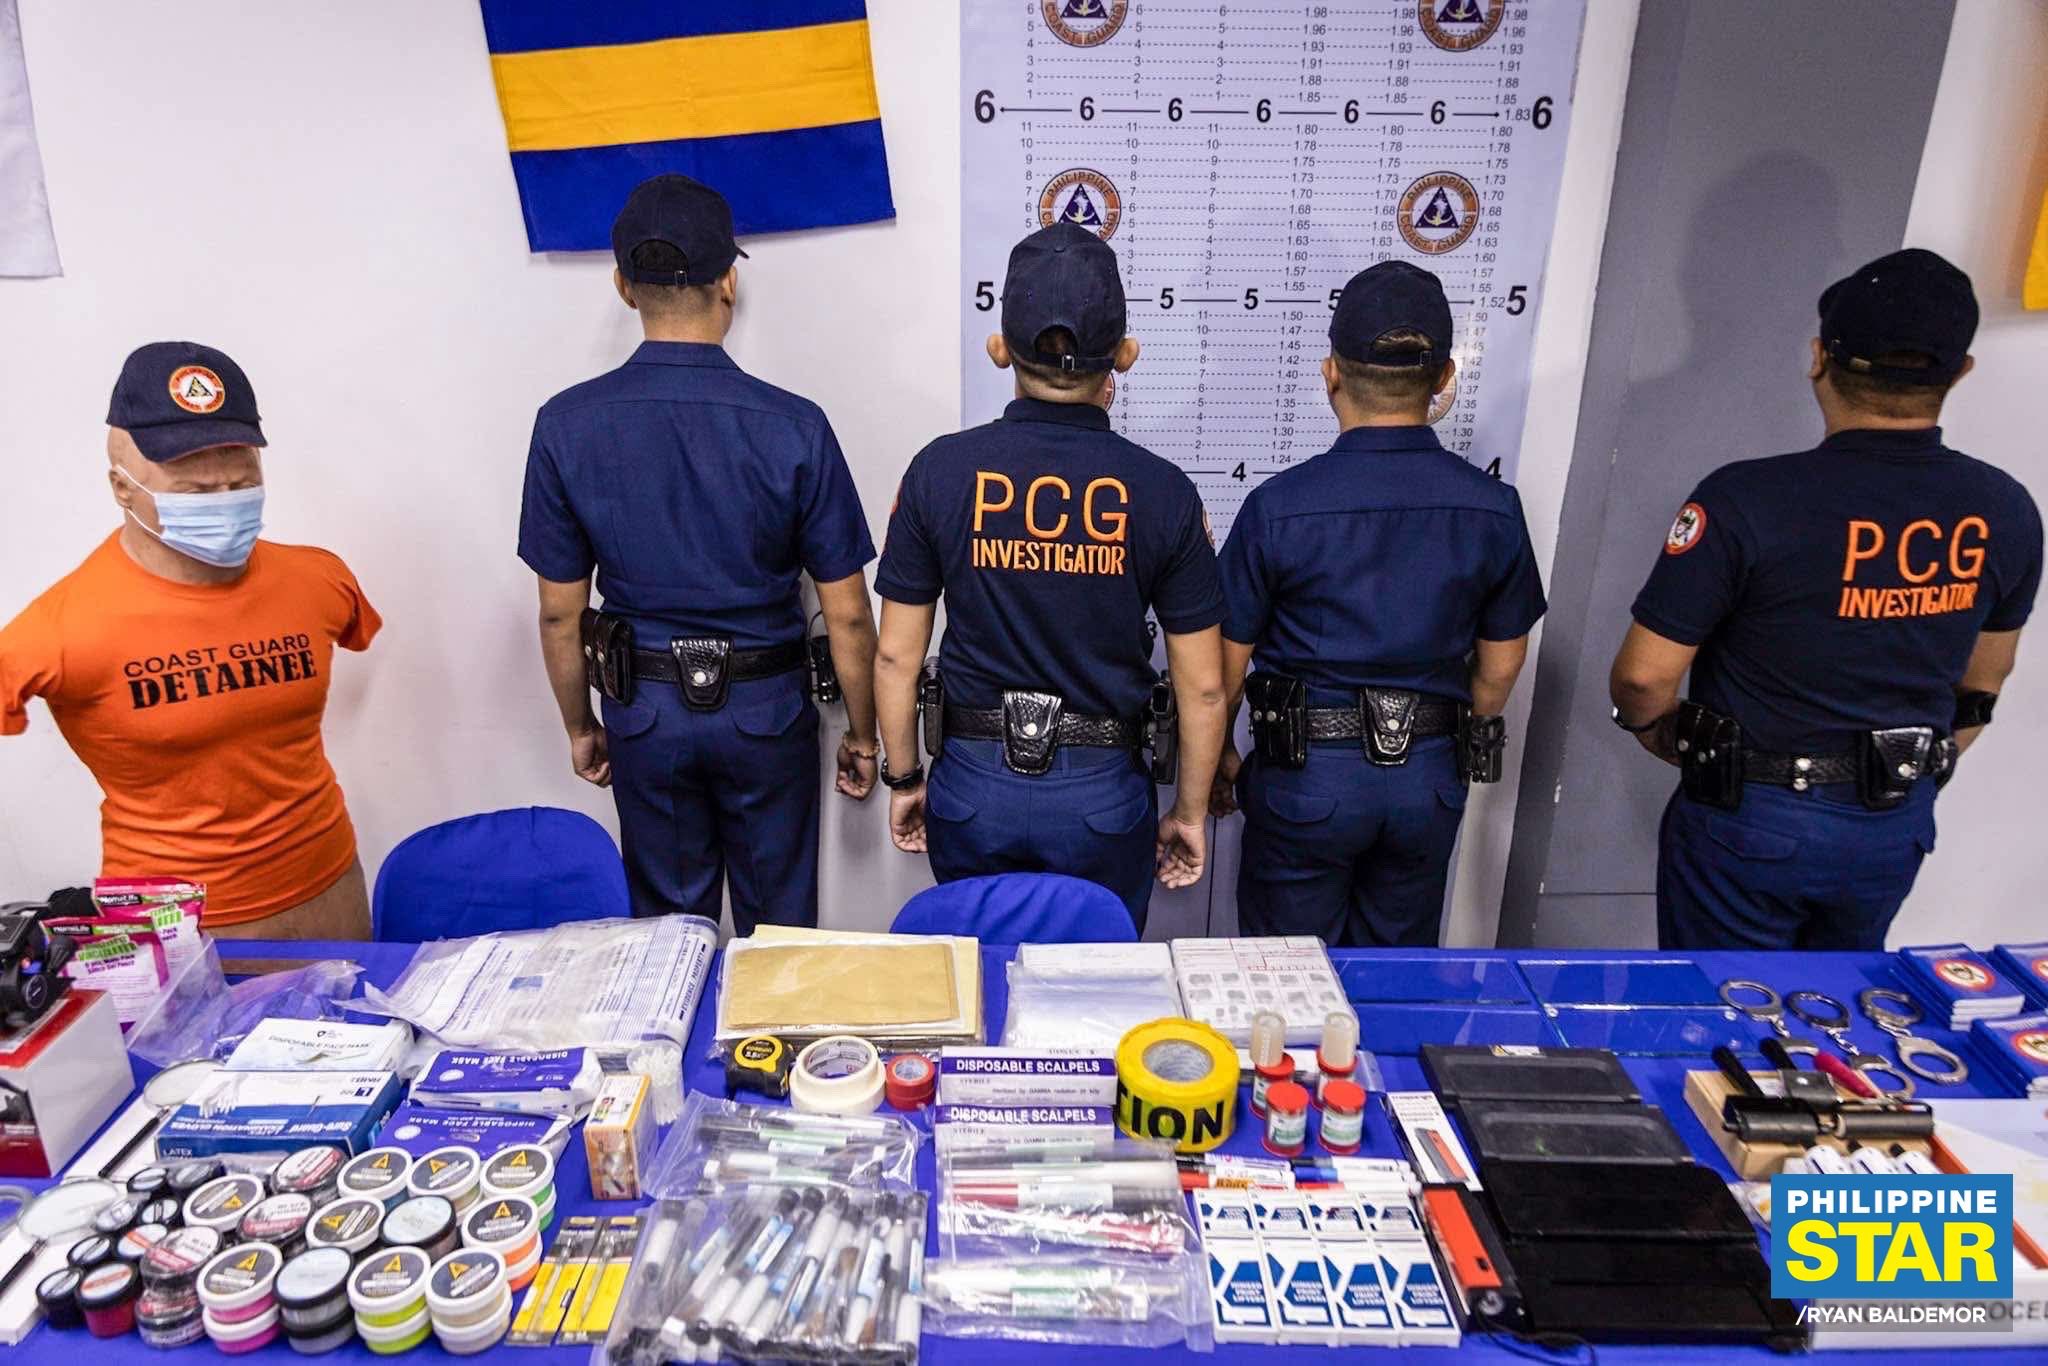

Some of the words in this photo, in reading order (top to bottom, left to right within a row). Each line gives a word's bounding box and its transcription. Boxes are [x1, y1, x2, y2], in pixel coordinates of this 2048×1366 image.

[1027, 4, 1034, 15] 6
[1136, 5, 1143, 16] 6
[1220, 6, 1226, 17] 6
[1306, 7, 1328, 18] 1.98
[1028, 21, 1034, 32] 5
[1135, 22, 1142, 33] 5
[1219, 23, 1226, 34] 5
[1305, 25, 1326, 35] 1.96
[1027, 38, 1034, 49] 4
[1135, 39, 1142, 50] 4
[1218, 40, 1225, 51] 4
[1303, 41, 1325, 52] 1.93
[1027, 55, 1034, 66] 3
[1134, 56, 1141, 67] 3
[1217, 57, 1224, 68] 3
[1301, 58, 1323, 69] 1.91
[1027, 72, 1034, 83] 2
[1134, 73, 1141, 84] 2
[1216, 74, 1223, 84] 2
[1300, 75, 1322, 86] 1.88
[1028, 89, 1033, 100] 1
[1135, 90, 1140, 100] 1
[1216, 90, 1221, 101] 1
[1299, 92, 1321, 102] 1.85
[974, 89, 995, 124] 6
[1080, 96, 1095, 122] 6
[1168, 97, 1183, 122] 6
[1256, 98, 1272, 123] 6
[1344, 99, 1360, 124] 6
[1430, 100, 1446, 125] 6
[1506, 110, 1530, 120] 1.83
[1532, 95, 1553, 130] 6
[1023, 122, 1032, 133] 11
[1128, 122, 1138, 132] 11
[1209, 123, 1219, 134] 11
[1296, 124, 1318, 135] 1.80
[1022, 138, 1033, 149] 10
[1127, 138, 1138, 149] 10
[1208, 139, 1219, 150] 10
[1295, 140, 1317, 151] 1.78
[1026, 154, 1033, 165] 9
[1131, 154, 1138, 165] 9
[1211, 155, 1218, 166] 9
[1294, 157, 1316, 168] 1.75
[1026, 170, 1032, 181] 8
[1130, 170, 1137, 181] 8
[1210, 171, 1216, 182] 8
[1292, 173, 1314, 184] 1.73
[1047, 171, 1114, 198] PHILIPPINE
[1407, 175, 1474, 201] PHILIPPINE
[1025, 186, 1032, 196] 7
[1129, 186, 1136, 197] 7
[1210, 187, 1216, 198] 7
[1291, 189, 1312, 199] 1.70
[1025, 202, 1032, 212] 6
[1129, 202, 1136, 213] 6
[1208, 203, 1215, 214] 6
[1290, 204, 1312, 215] 1.68
[1026, 217, 1032, 228] 5
[1128, 218, 1135, 229] 5
[1208, 219, 1214, 229] 5
[1288, 220, 1310, 231] 1.65
[1128, 234, 1134, 244] 4
[1206, 234, 1213, 244] 4
[1287, 235, 1309, 246] 1.63
[1127, 250, 1134, 260] 3
[1206, 250, 1212, 259] 3
[1286, 251, 1307, 261] 1.60
[1126, 265, 1133, 275] 2
[1205, 265, 1211, 275] 2
[1285, 266, 1306, 276] 1.57
[1127, 280, 1132, 290] 1
[1206, 281, 1210, 290] 1
[1284, 281, 1305, 291] 1.55
[976, 281, 995, 312] 5
[1160, 288, 1174, 309] 5
[1245, 288, 1259, 310] 5
[1480, 297, 1505, 307] 1.52
[1506, 285, 1527, 316] 5
[1199, 310, 1208, 320] 11
[1282, 311, 1303, 321] 1.50
[1197, 325, 1208, 334] 10
[1280, 326, 1301, 336] 1.47
[1200, 340, 1207, 350] 9
[1279, 341, 1300, 351] 1.45
[1200, 354, 1206, 364] 8
[1278, 355, 1299, 365] 1.42
[1199, 369, 1206, 379] 7
[1277, 370, 1298, 380] 1.40
[1122, 383, 1129, 393] 6
[1198, 383, 1205, 393] 6
[1276, 384, 1296, 394] 1.37
[1122, 397, 1129, 407] 5
[1198, 397, 1204, 407] 5
[1275, 398, 1295, 408] 1.35
[1121, 411, 1128, 421] 4
[1197, 412, 1204, 422] 4
[1274, 413, 1294, 423] 1.32
[1120, 425, 1127, 435] 3
[1196, 426, 1202, 435] 3
[1273, 427, 1293, 437] 1.30
[1194, 440, 1201, 450] 2
[1272, 440, 1292, 450] 1.27
[1195, 454, 1200, 464] 1
[1270, 454, 1291, 464] 1.24
[1232, 462, 1246, 482] 4
[972, 470, 1129, 543] PCG
[972, 538, 1126, 575] INVESTIGATOR
[1841, 516, 1990, 584] PCG
[1838, 582, 1980, 619] INVESTIGATOR
[123, 647, 217, 678] COAST
[229, 633, 310, 660] GUARD
[128, 649, 317, 710] DETAINEE
[956, 1059, 1033, 1073] DISPOSABLE
[1036, 1060, 1100, 1073] SCALPELS
[950, 1107, 1029, 1123] DISPOSABLE
[1031, 1109, 1096, 1122] SCALPELS
